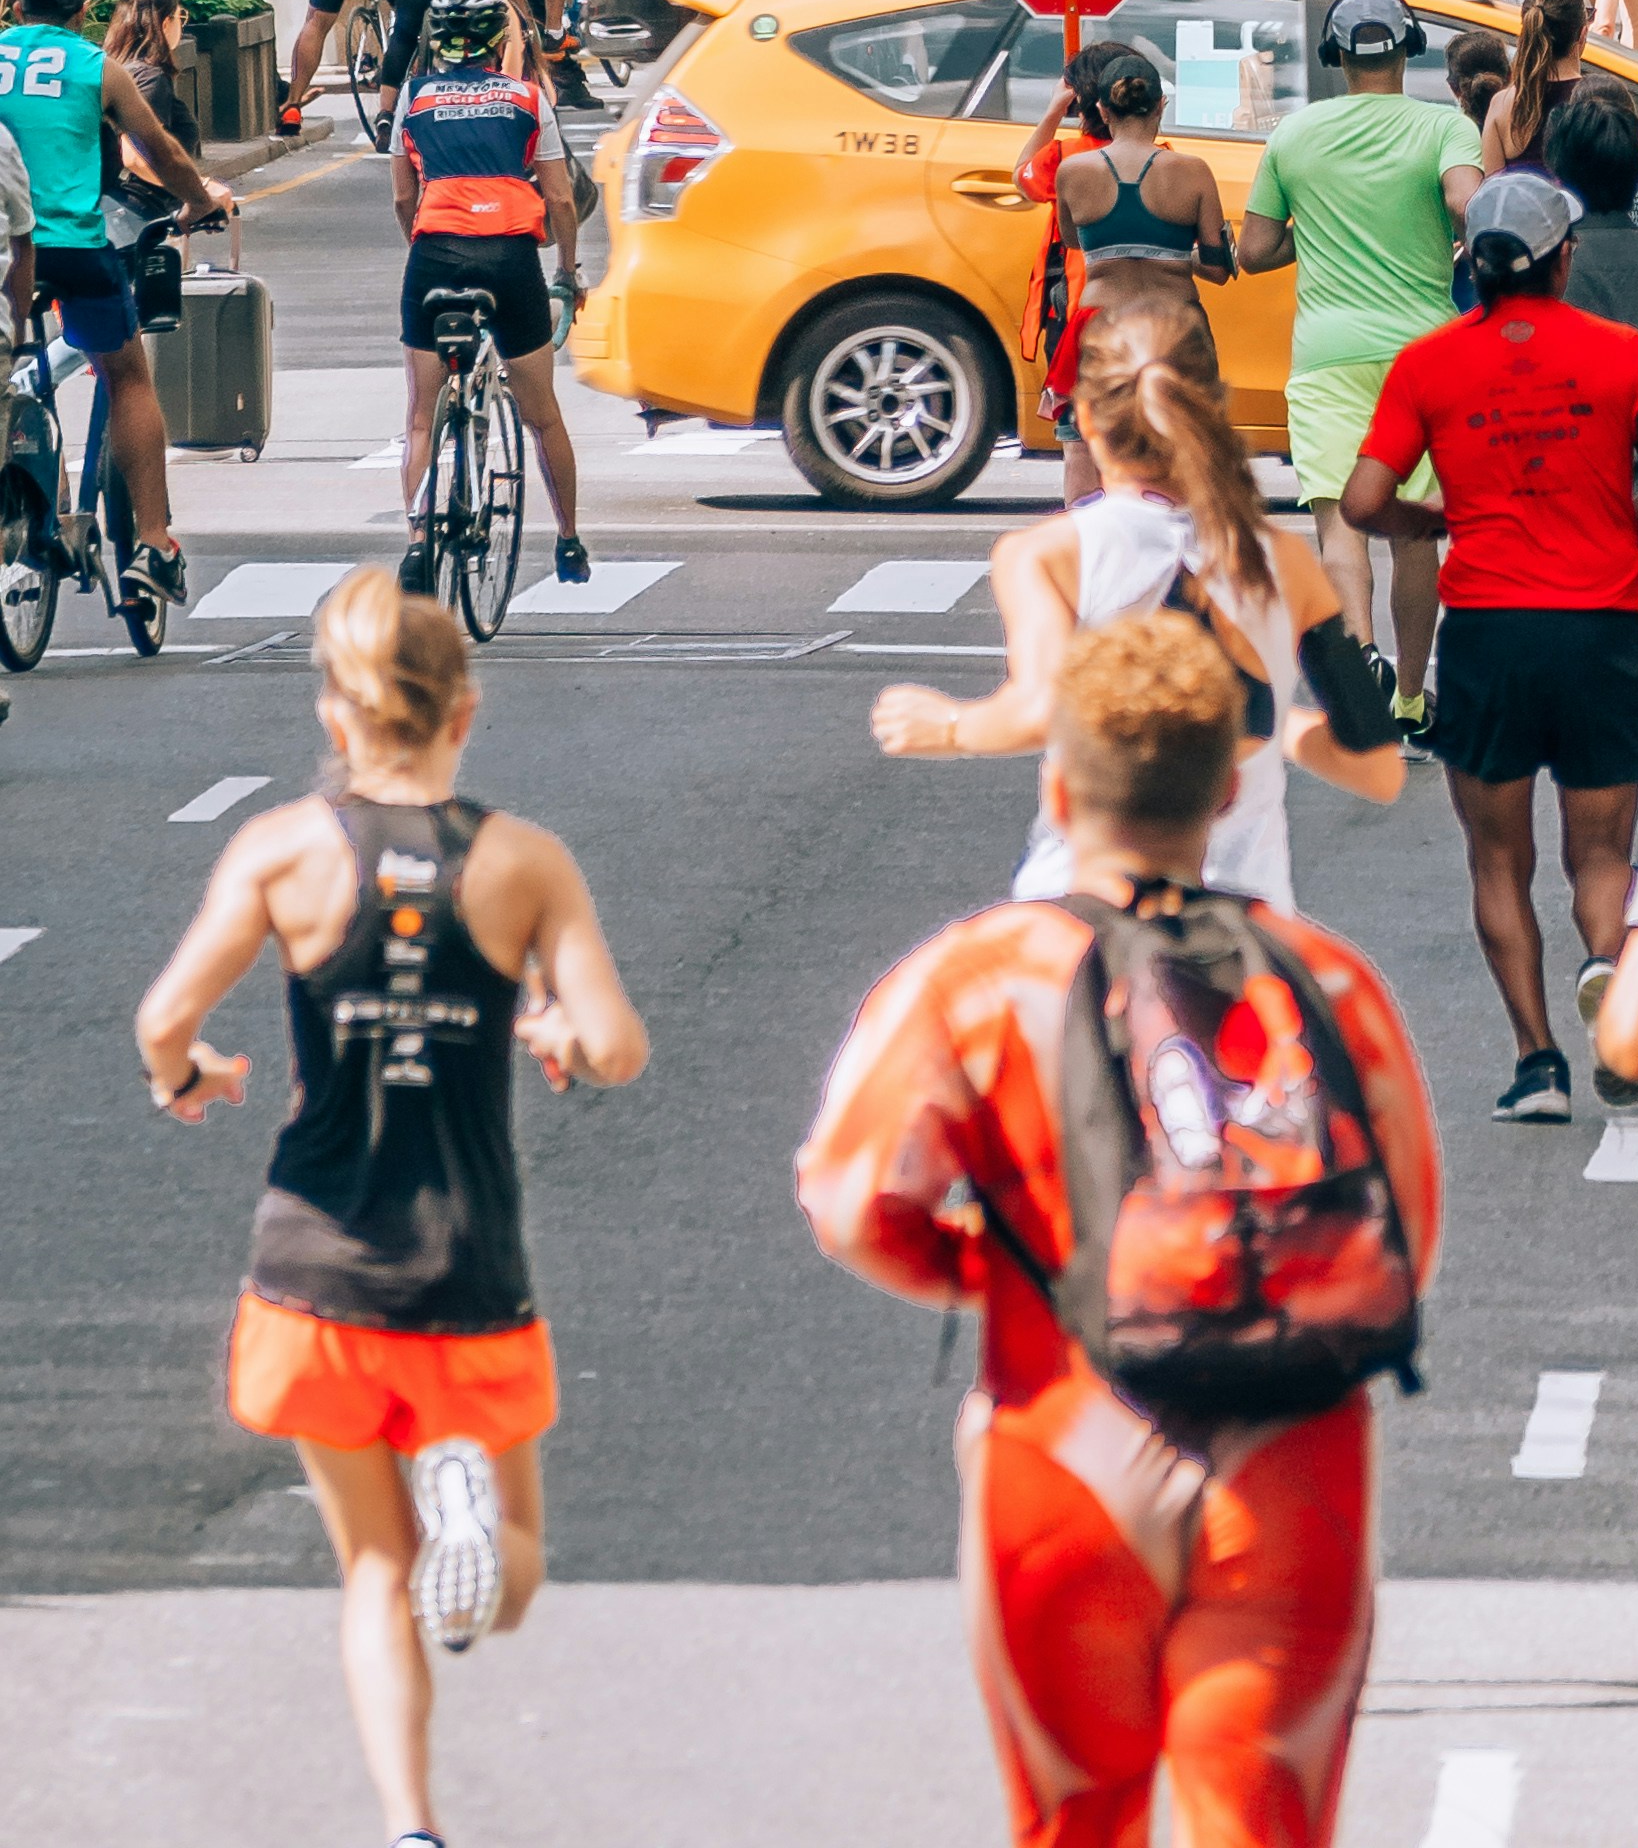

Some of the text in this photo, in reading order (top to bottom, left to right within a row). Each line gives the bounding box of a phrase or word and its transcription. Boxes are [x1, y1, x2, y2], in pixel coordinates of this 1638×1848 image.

[435, 81, 511, 94] NEW YORK
[435, 92, 513, 104] CYCLE CLUB
[437, 106, 514, 119] RIDE LEADER
[835, 131, 919, 155] 1W38
